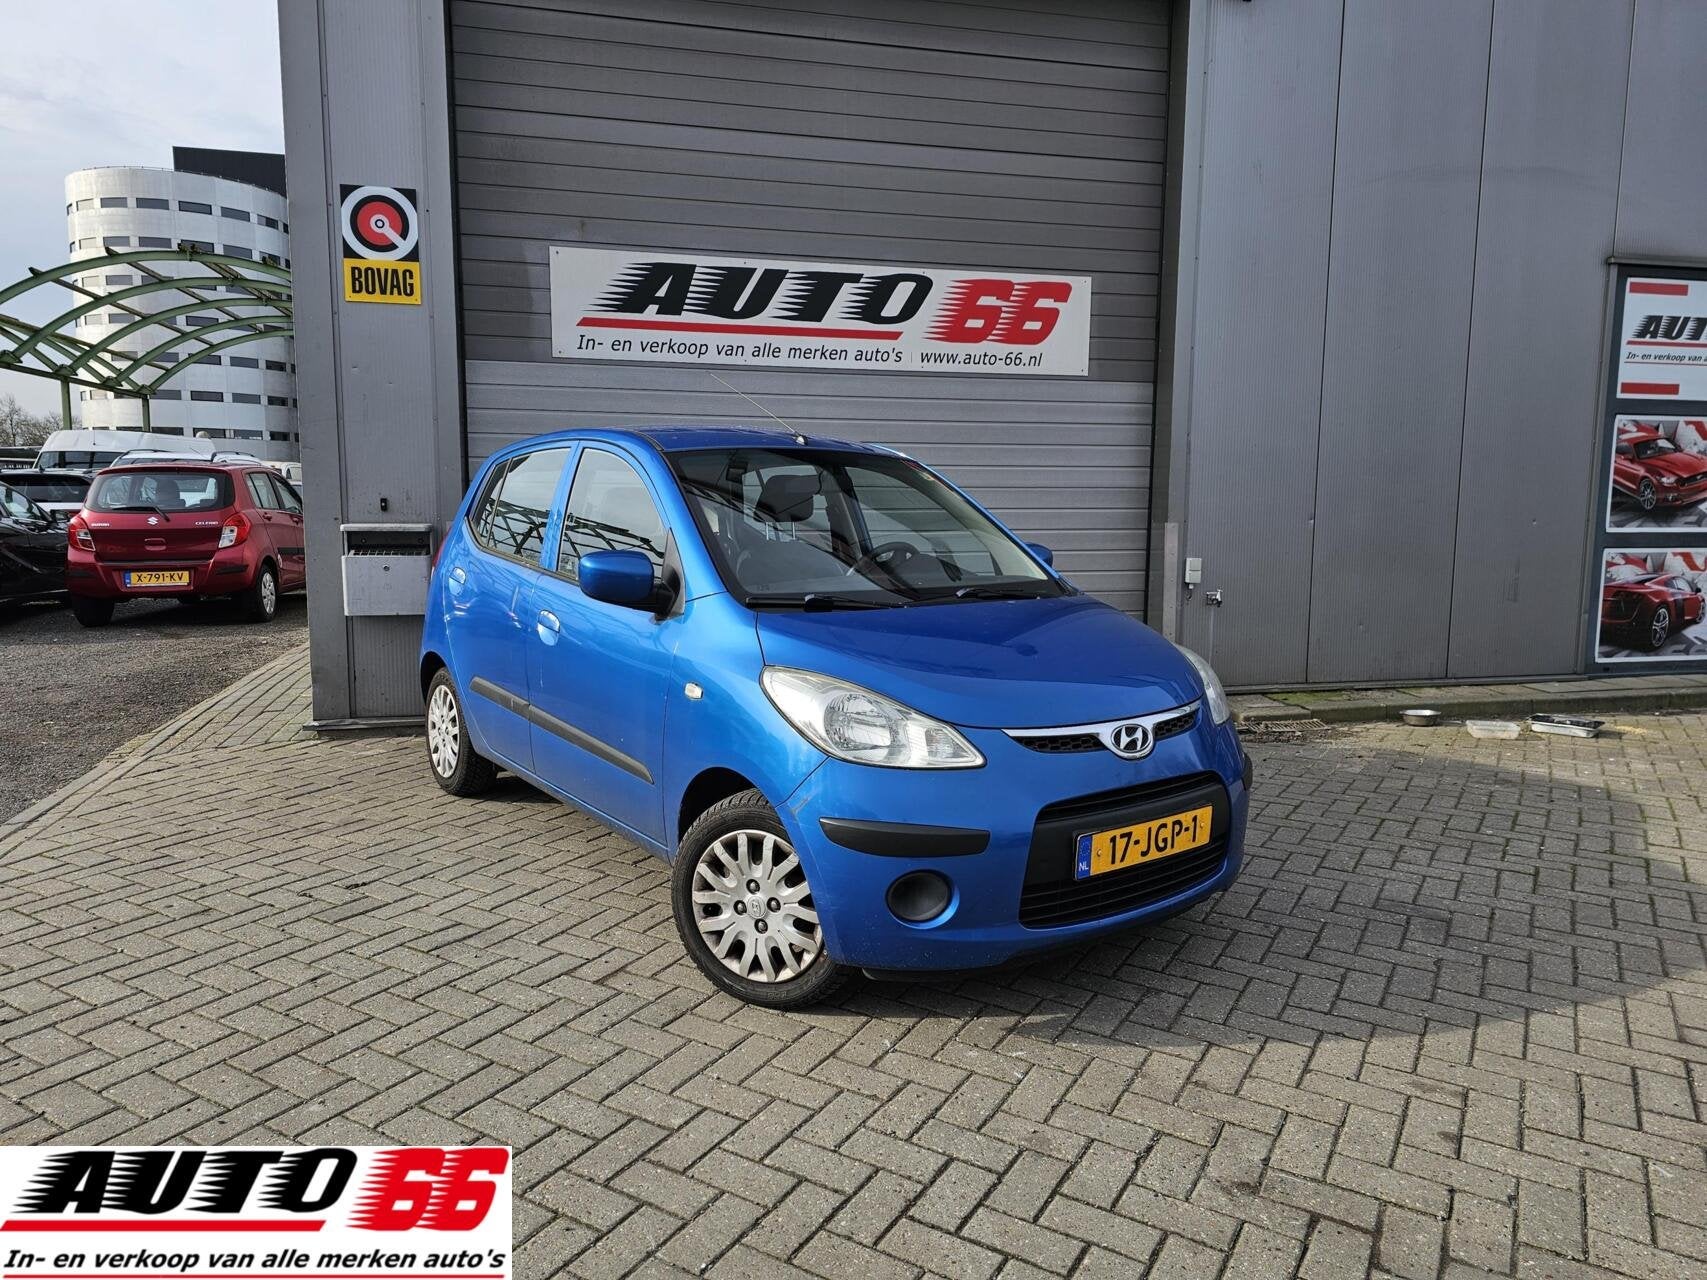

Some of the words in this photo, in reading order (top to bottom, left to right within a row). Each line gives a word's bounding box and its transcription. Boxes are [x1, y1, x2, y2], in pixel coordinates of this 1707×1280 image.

[350, 266, 415, 297] BOVAG
[582, 261, 934, 325] AUTO
[922, 278, 1073, 346] 66
[1631, 314, 1707, 341] AUT
[576, 334, 604, 351] In-
[610, 337, 633, 352] en
[639, 338, 709, 359] verkoop
[715, 343, 745, 357] van
[751, 342, 782, 358] alle
[787, 344, 849, 361] merken
[854, 346, 904, 363] auto's
[920, 351, 1043, 367] www.auto-66.nl
[1626, 351, 1640, 360] In-
[1641, 353, 1652, 361] en
[1654, 352, 1685, 363] verkoop
[1688, 354, 1703, 362] van
[136, 572, 184, 583] X-791-KV
[1109, 814, 1199, 865] 17-JGP-1
[1078, 861, 1090, 872] NL
